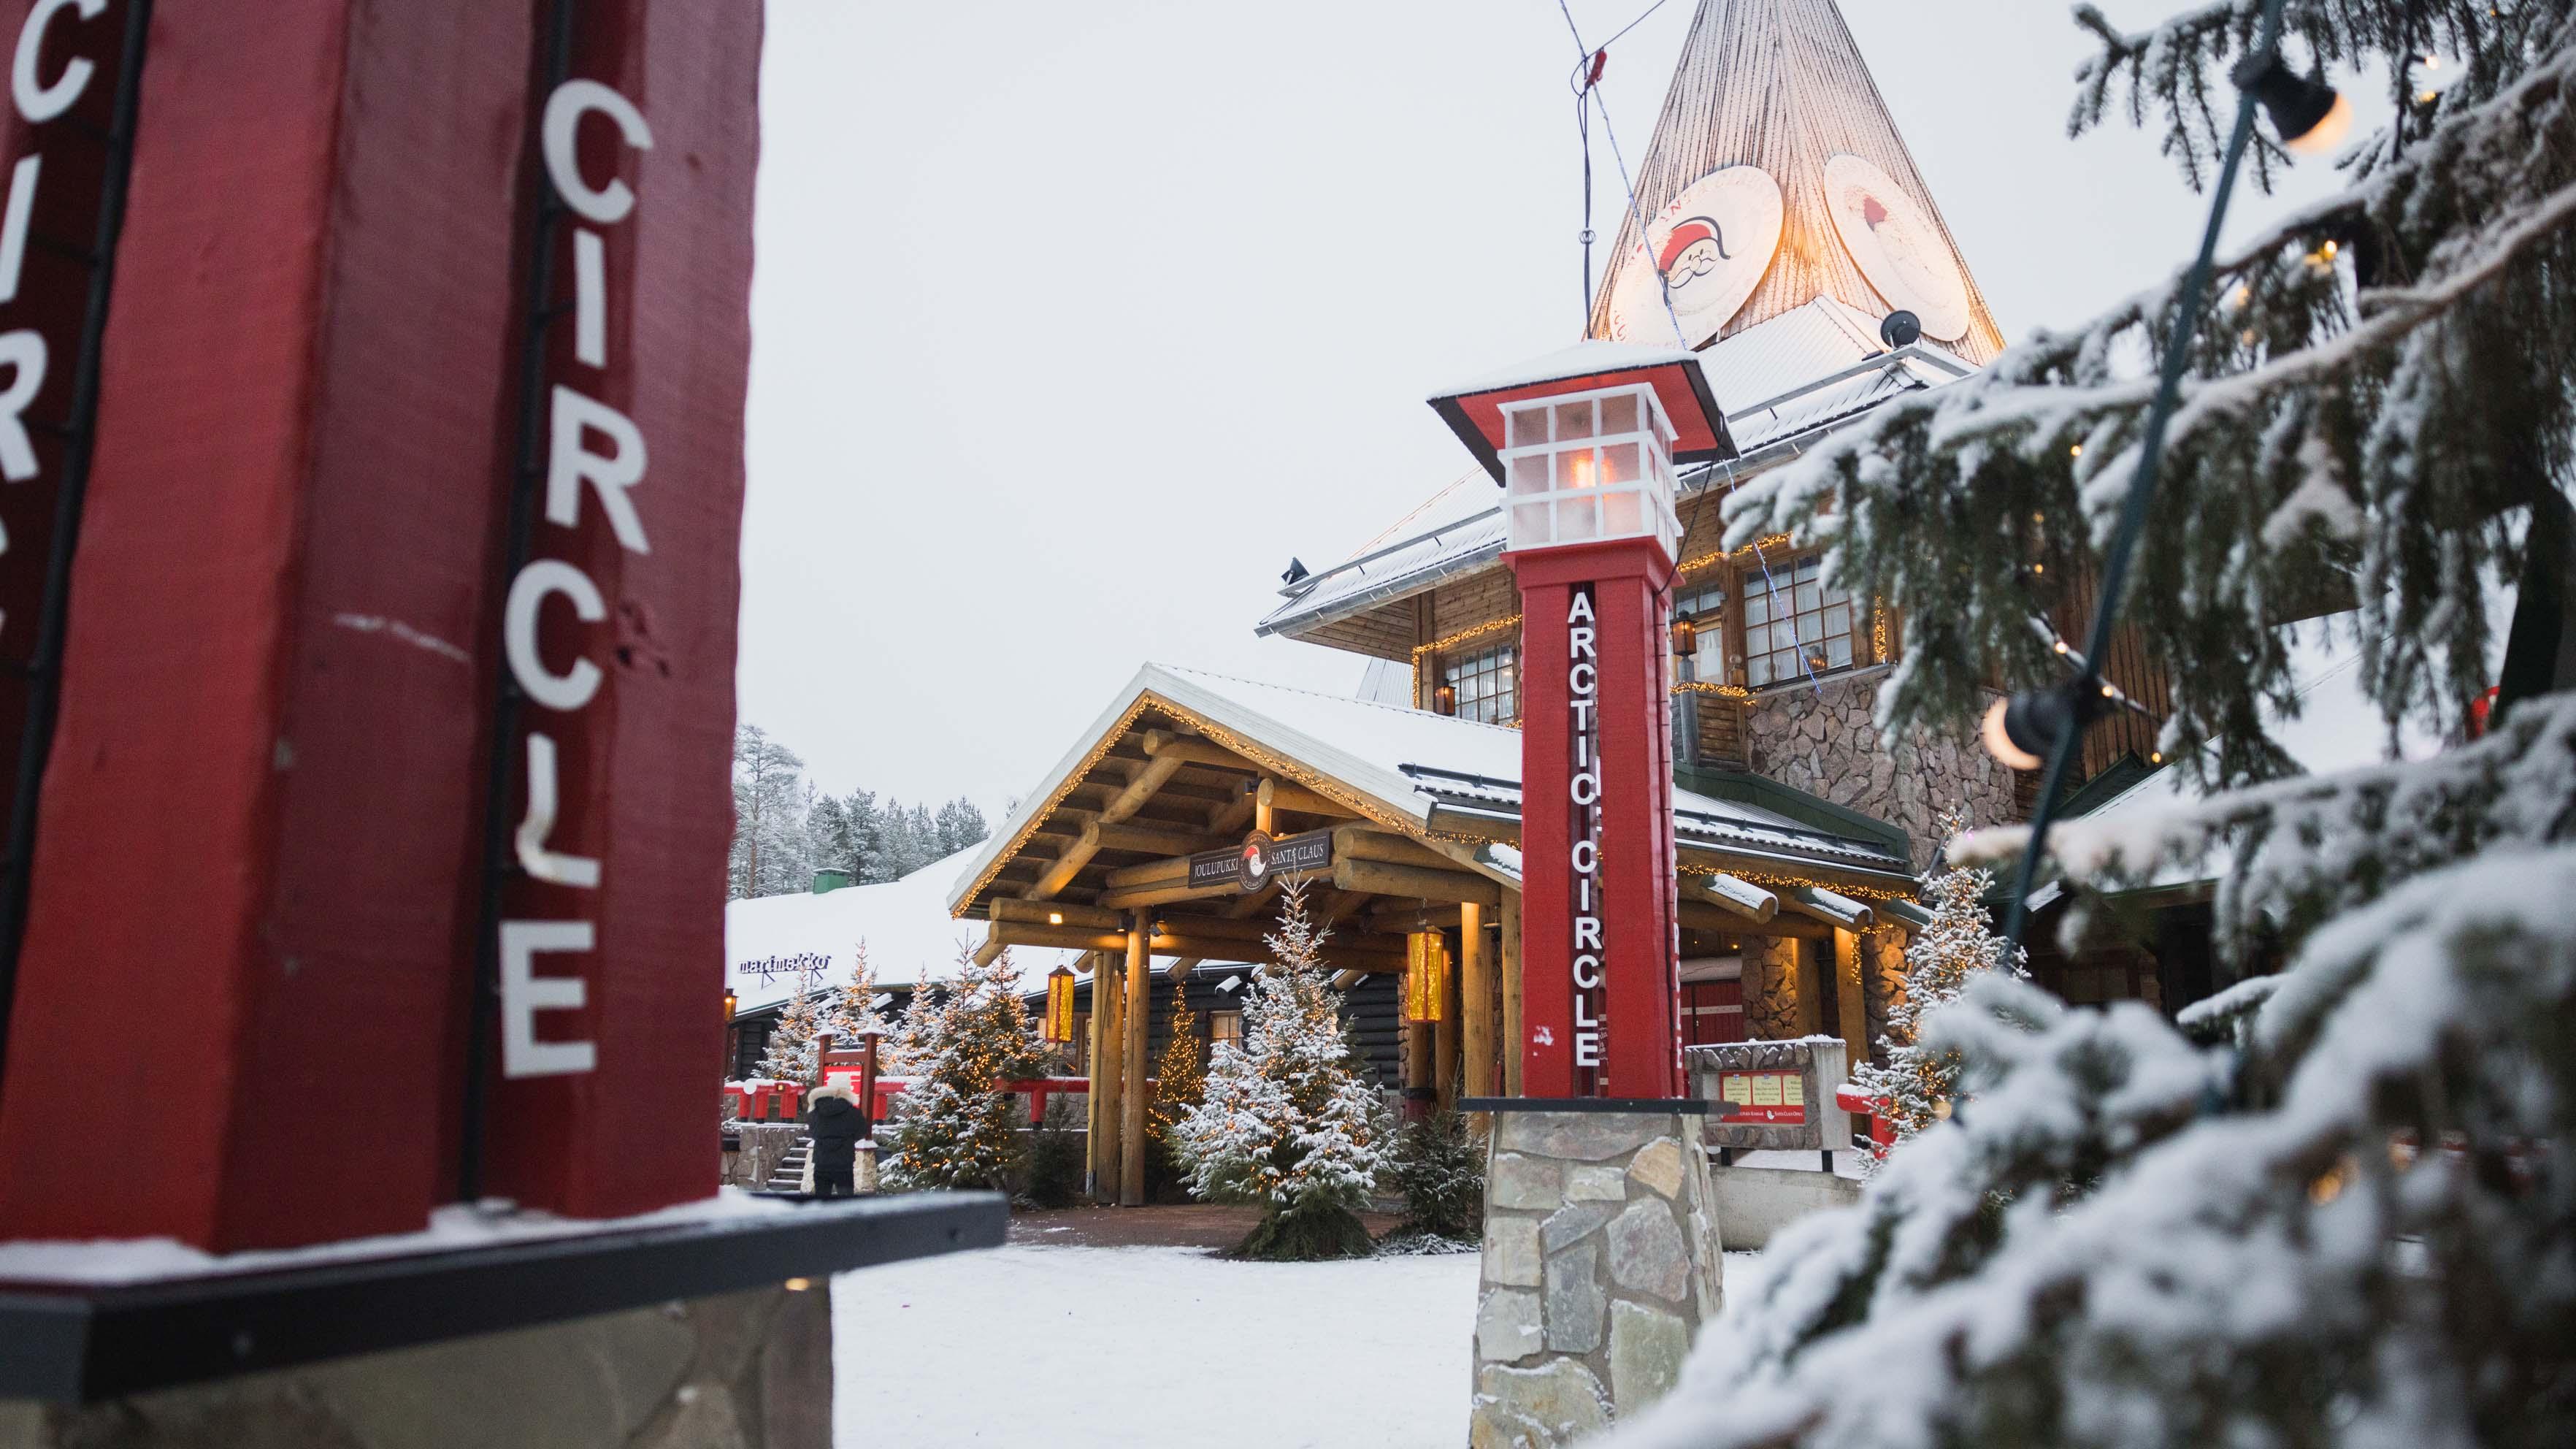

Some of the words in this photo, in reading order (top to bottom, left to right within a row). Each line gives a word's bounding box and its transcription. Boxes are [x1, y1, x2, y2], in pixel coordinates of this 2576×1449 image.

[499, 78, 653, 1080] CIRCLE
[1568, 592, 1597, 805] ARCTIC
[1195, 857, 1239, 879] JOULUPUKKI
[1271, 847, 1297, 865] SANTA
[1297, 844, 1324, 860] CLAUS
[737, 952, 830, 974] marimekko
[1571, 840, 1602, 1067] CIRCLE
